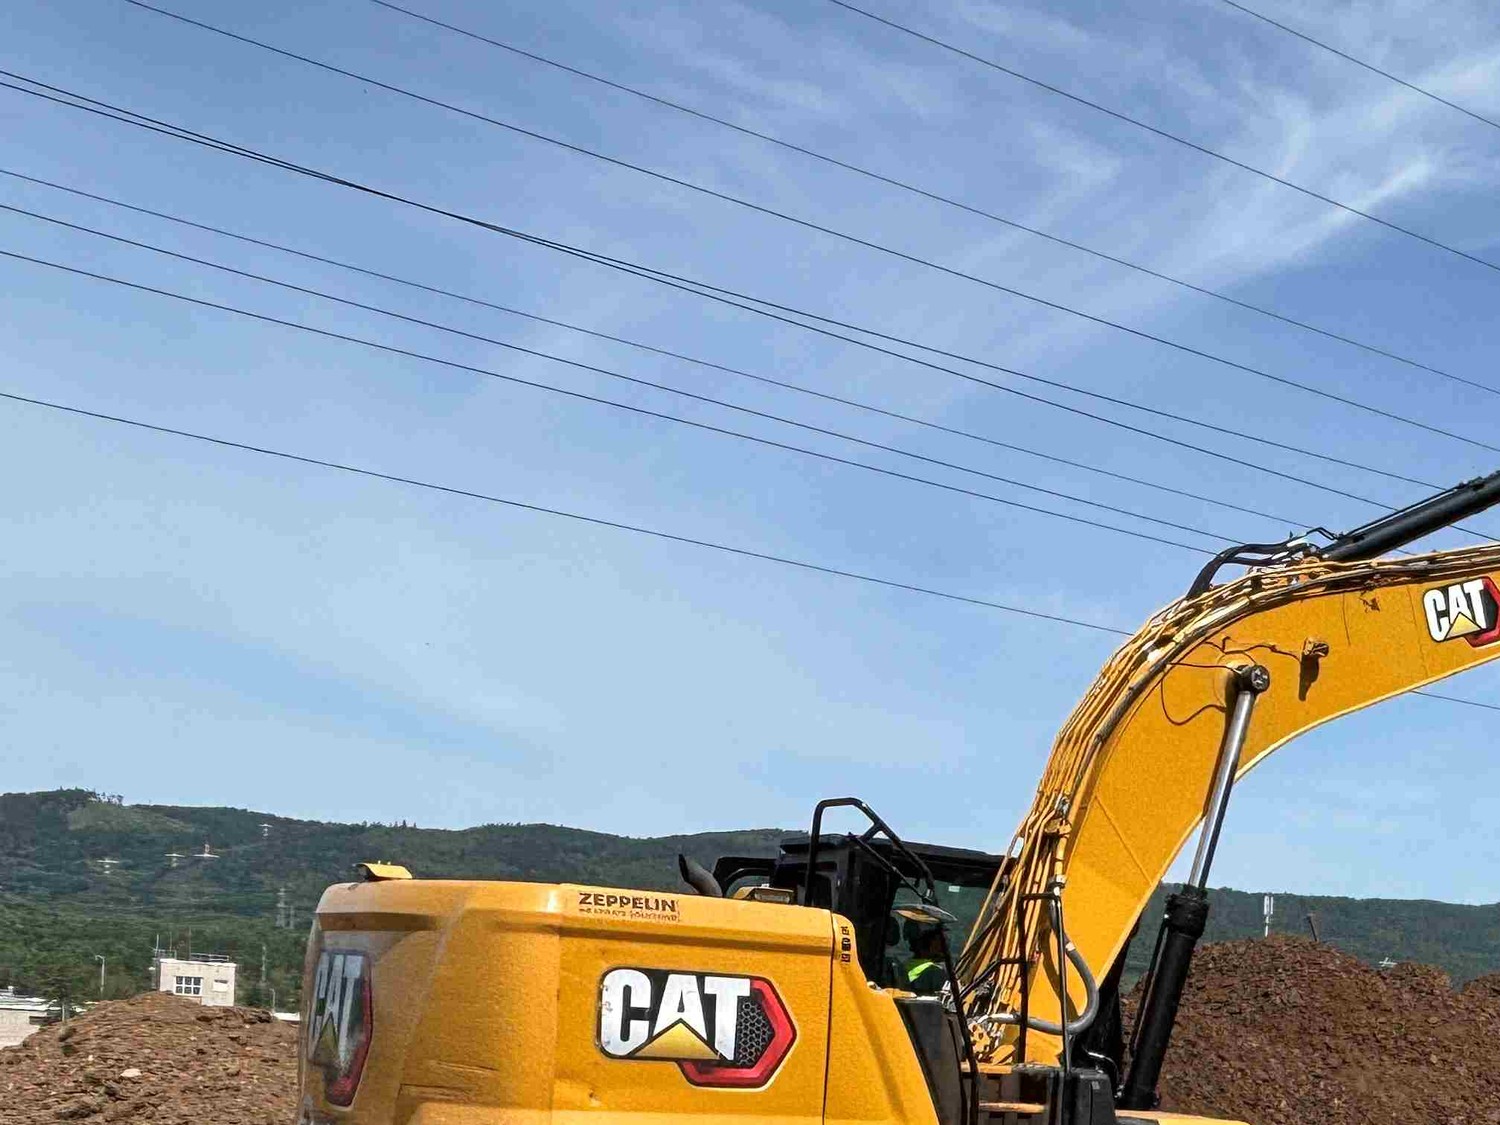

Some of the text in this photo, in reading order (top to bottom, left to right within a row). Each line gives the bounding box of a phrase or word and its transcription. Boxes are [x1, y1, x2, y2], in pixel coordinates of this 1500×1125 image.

[1423, 578, 1487, 642] CAT
[578, 892, 677, 912] ZEPPELIN
[308, 951, 364, 1065] CAT
[600, 968, 752, 1061] CAT
